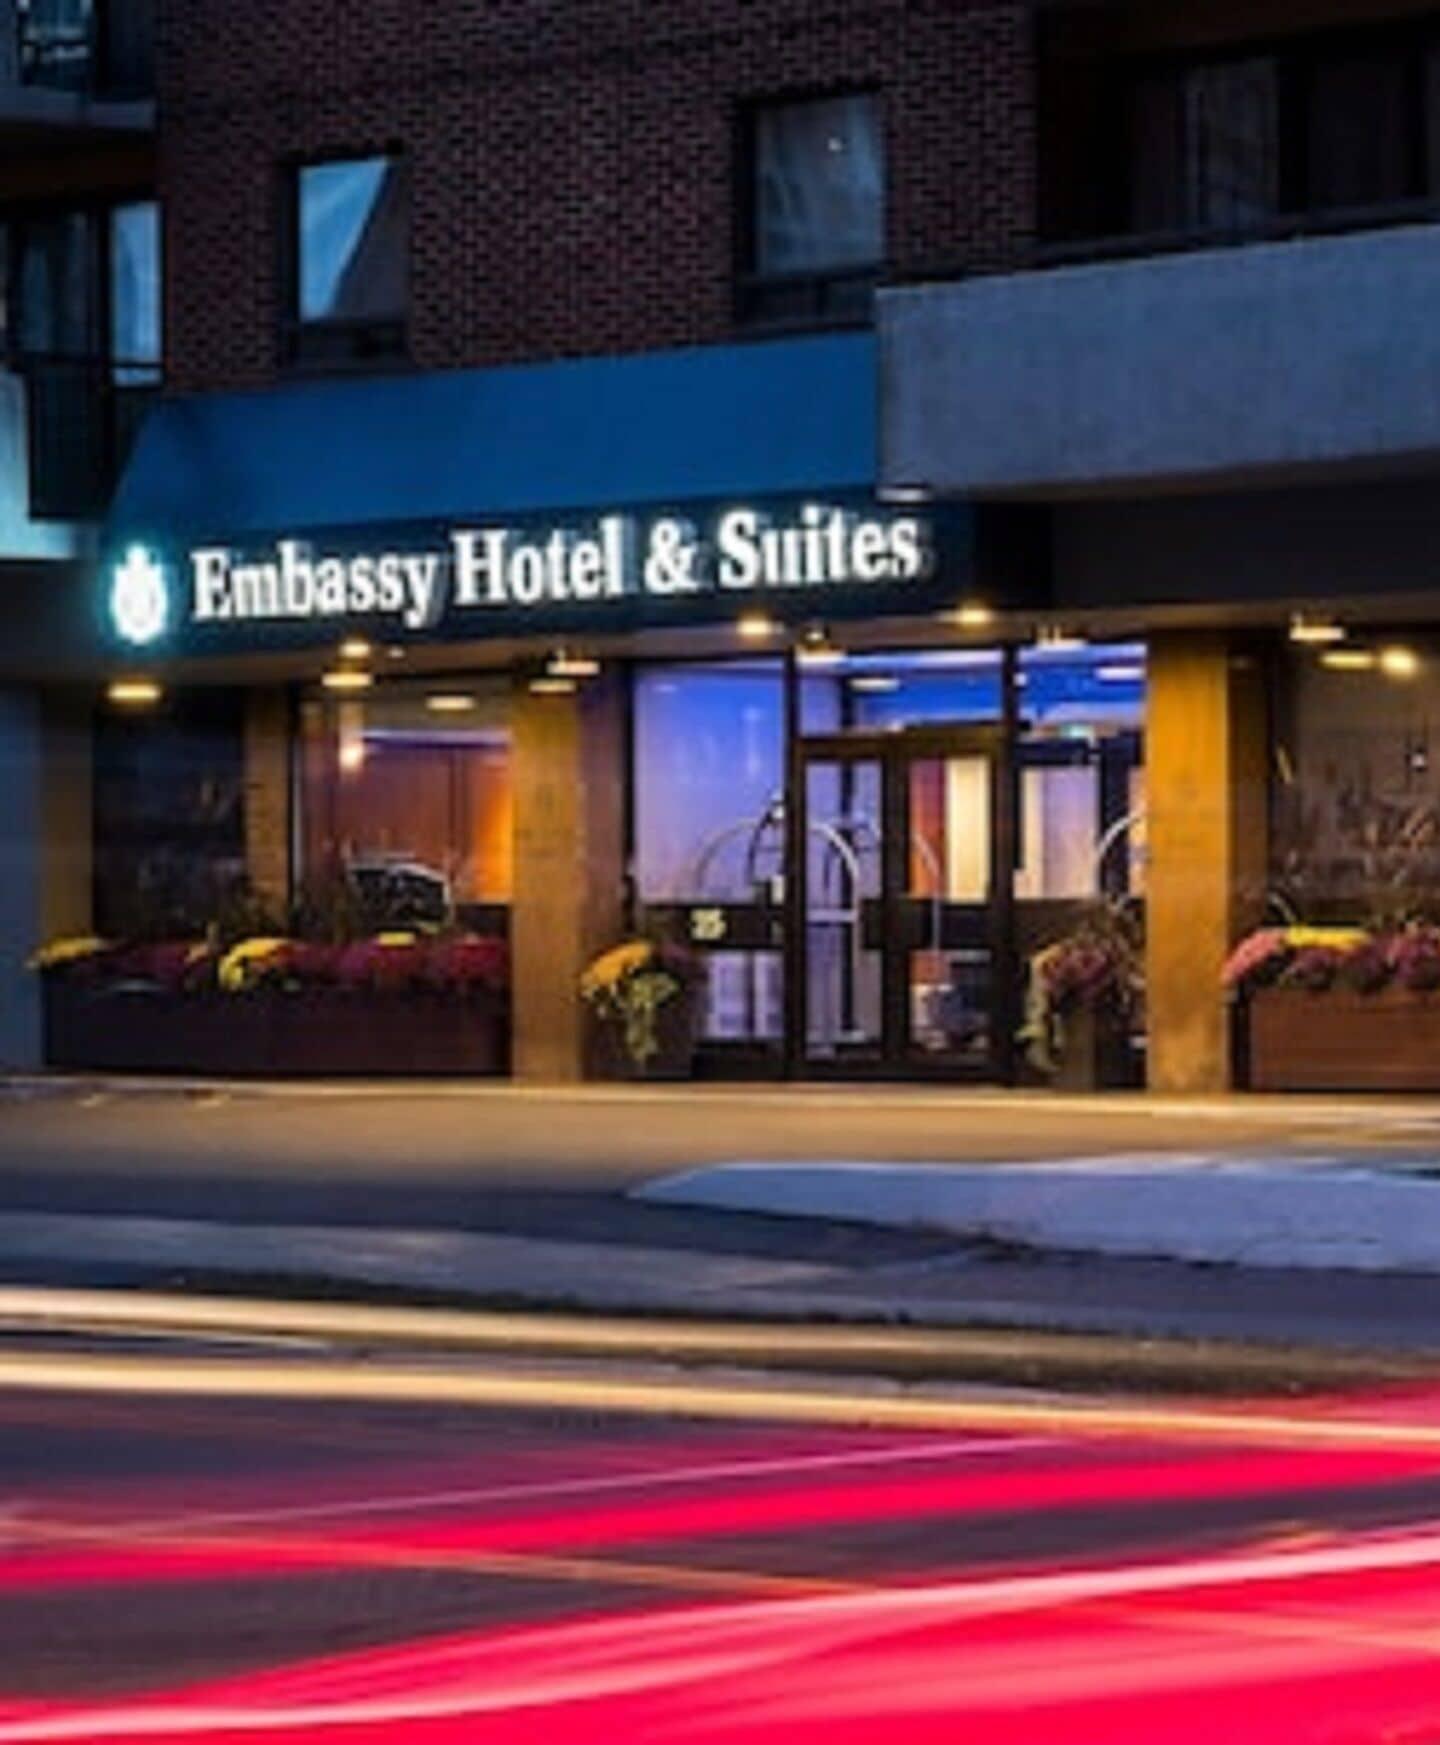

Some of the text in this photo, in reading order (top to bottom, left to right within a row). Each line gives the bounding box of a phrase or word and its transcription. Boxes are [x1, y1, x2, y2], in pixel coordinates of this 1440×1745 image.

[190, 504, 921, 630] Embassy Hotel & Suites
